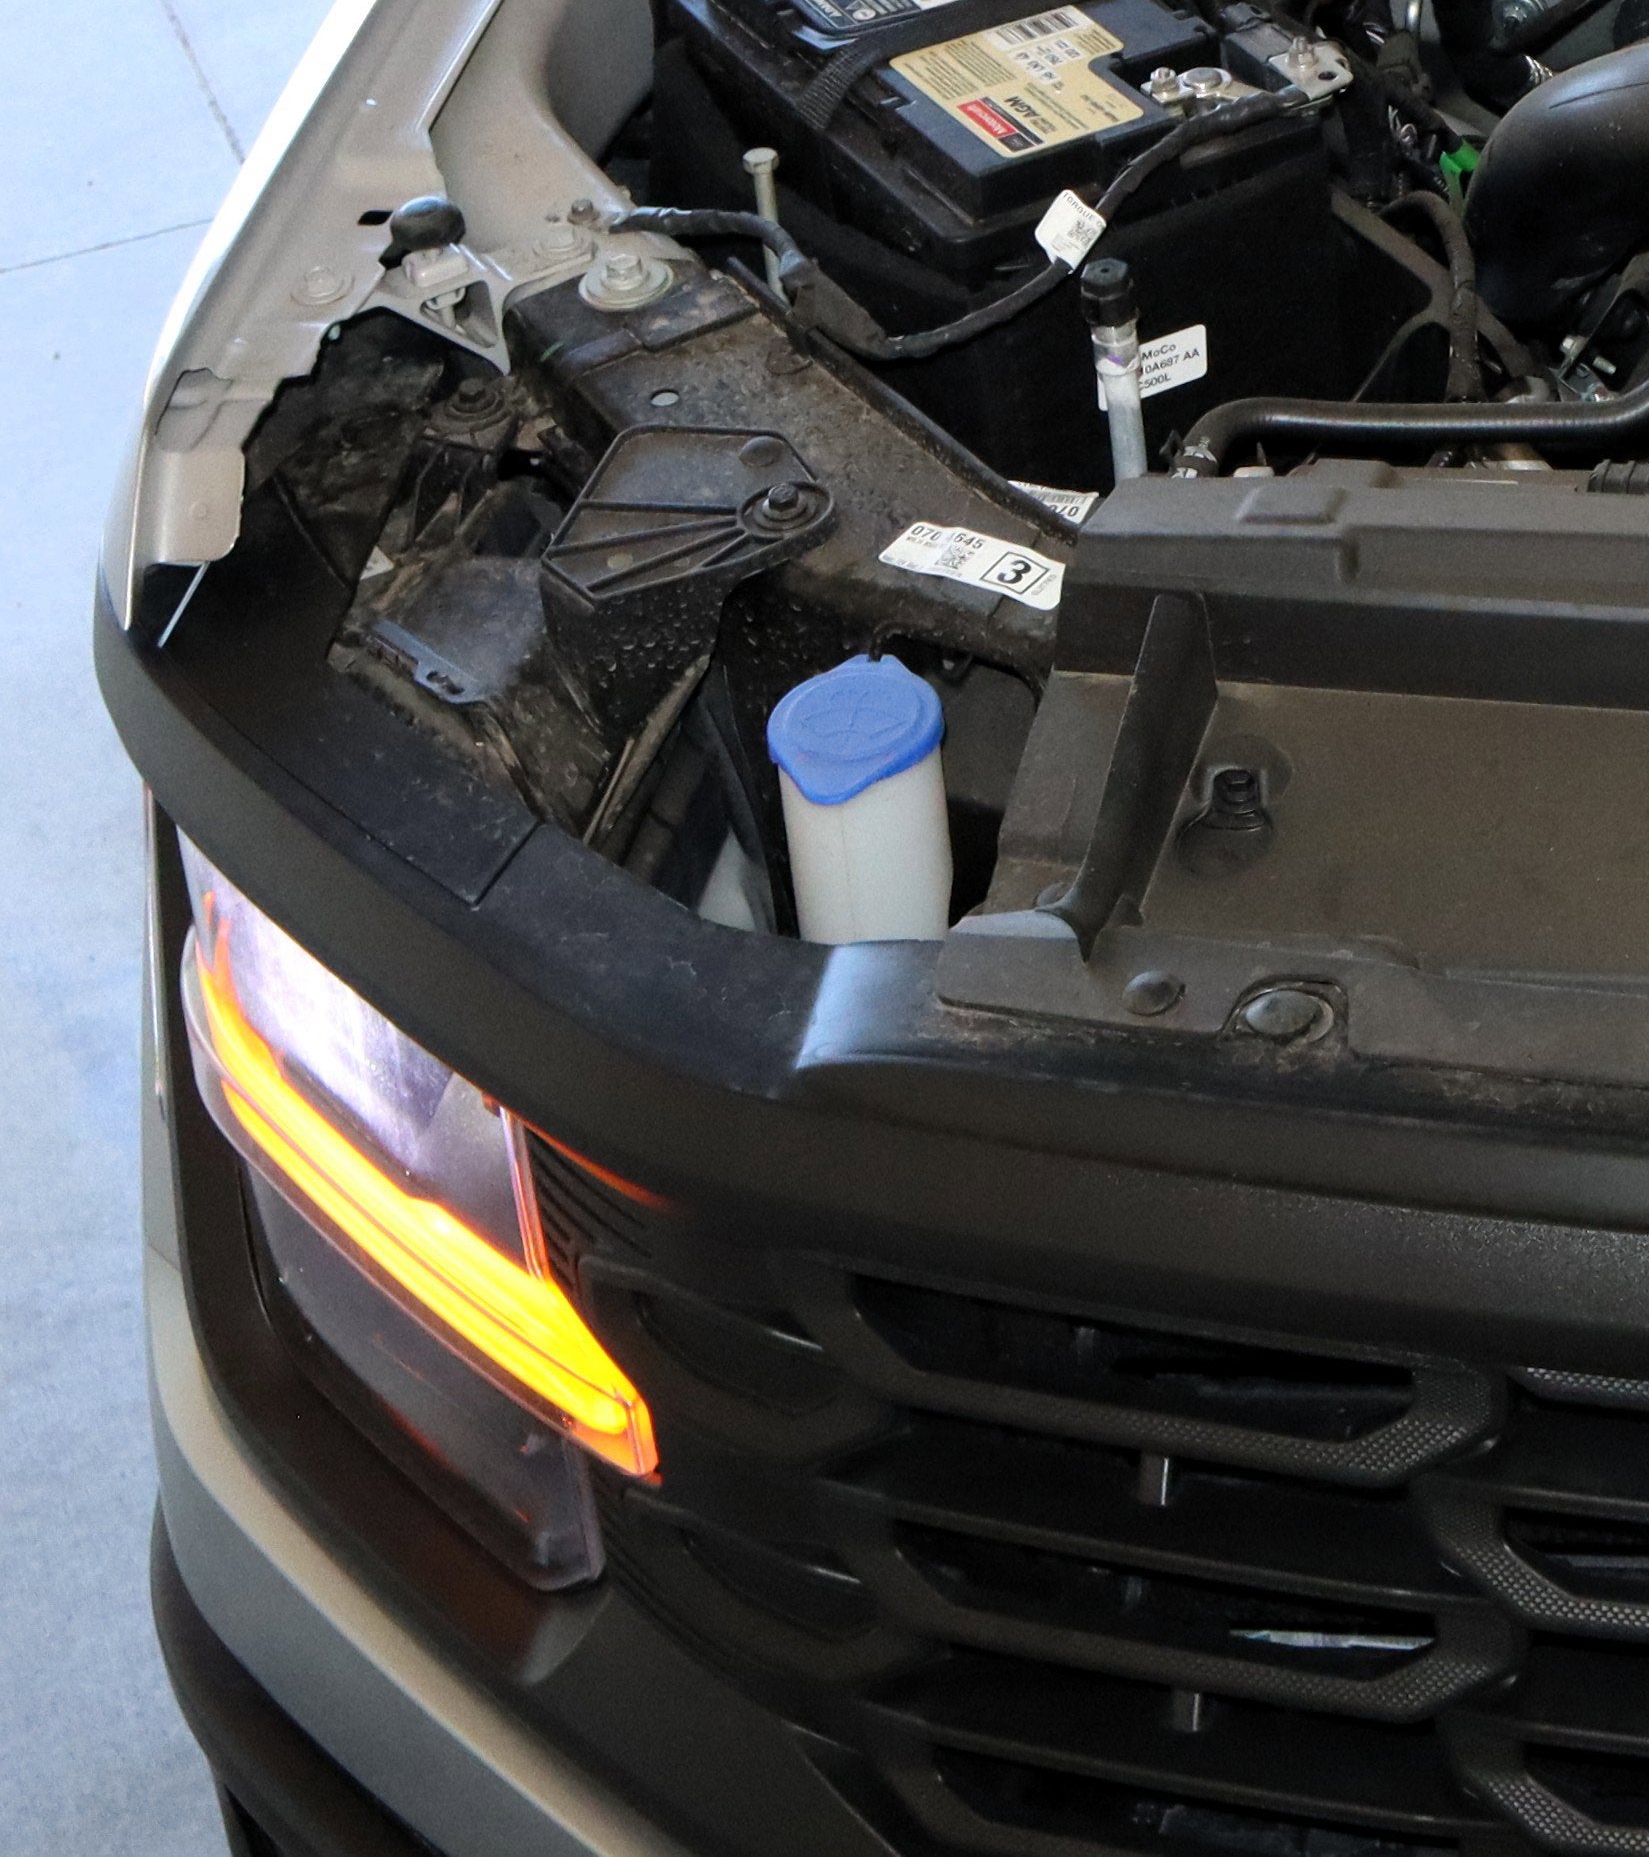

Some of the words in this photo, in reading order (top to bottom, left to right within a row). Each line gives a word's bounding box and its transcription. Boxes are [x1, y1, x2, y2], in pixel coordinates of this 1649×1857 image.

[1004, 95, 1041, 119] AGM
[1062, 191, 1096, 221] TORQUE
[1183, 348, 1200, 361] AA
[997, 559, 1032, 585] 3
